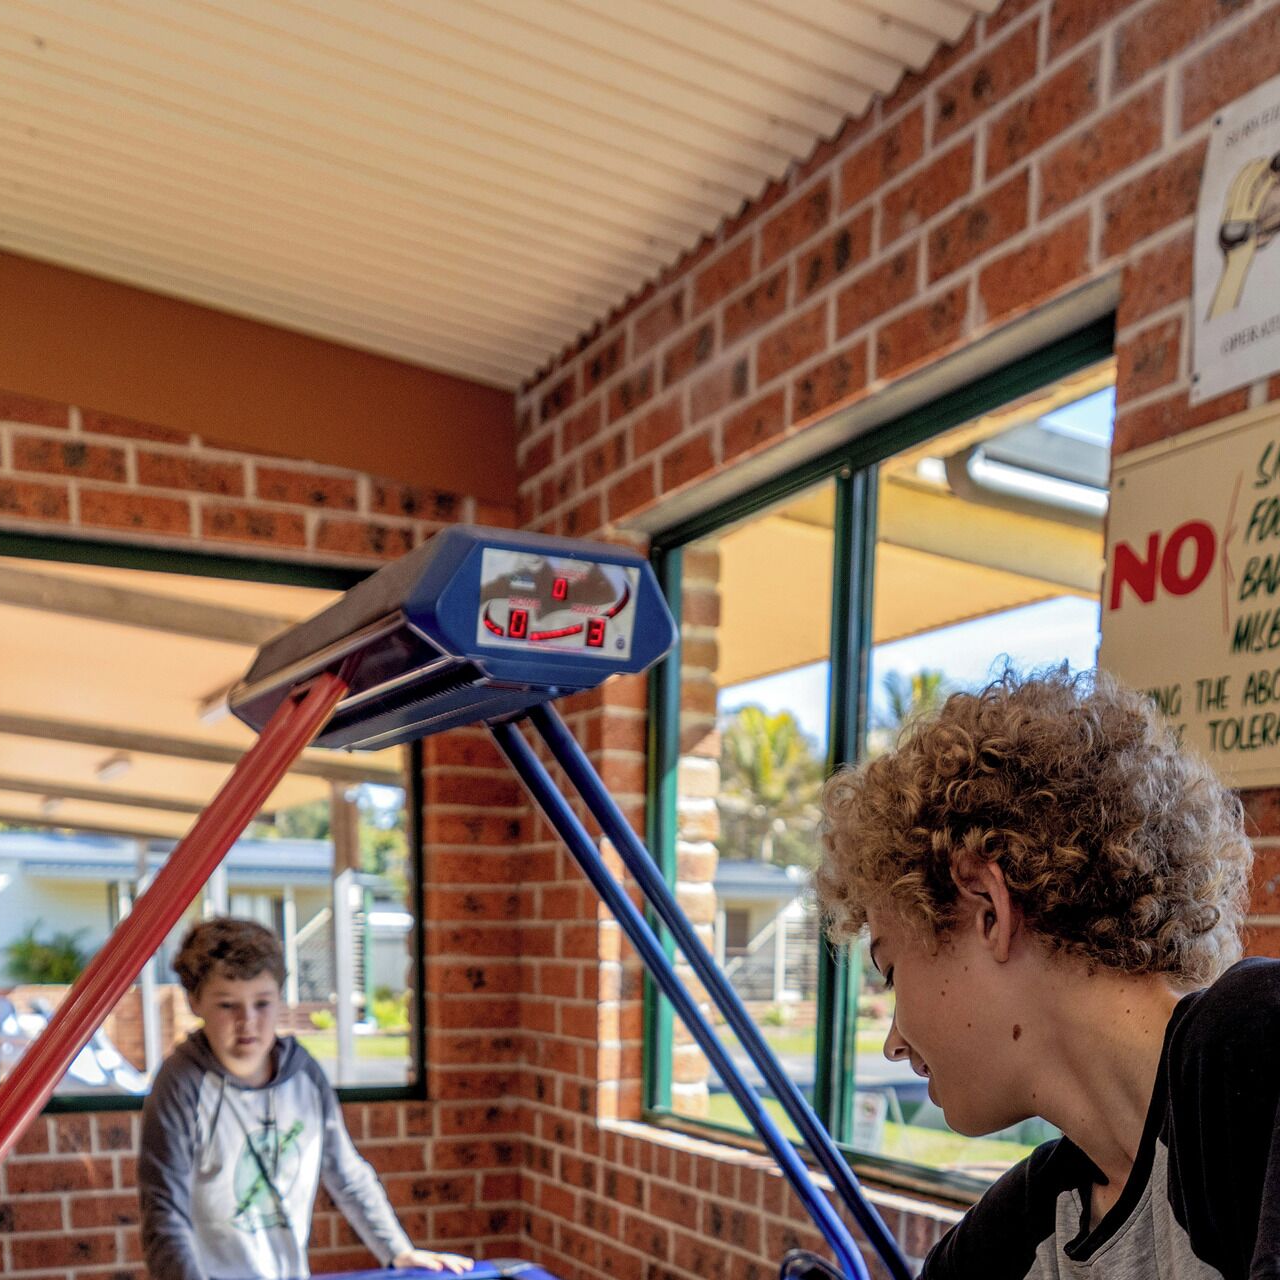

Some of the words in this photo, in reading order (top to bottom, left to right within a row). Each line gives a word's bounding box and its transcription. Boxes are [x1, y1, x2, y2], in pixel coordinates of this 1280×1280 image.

[1109, 518, 1218, 611] NO
[552, 577, 568, 601] 0
[509, 609, 528, 638] 0
[588, 617, 606, 647] 3
[1195, 675, 1231, 713] THE
